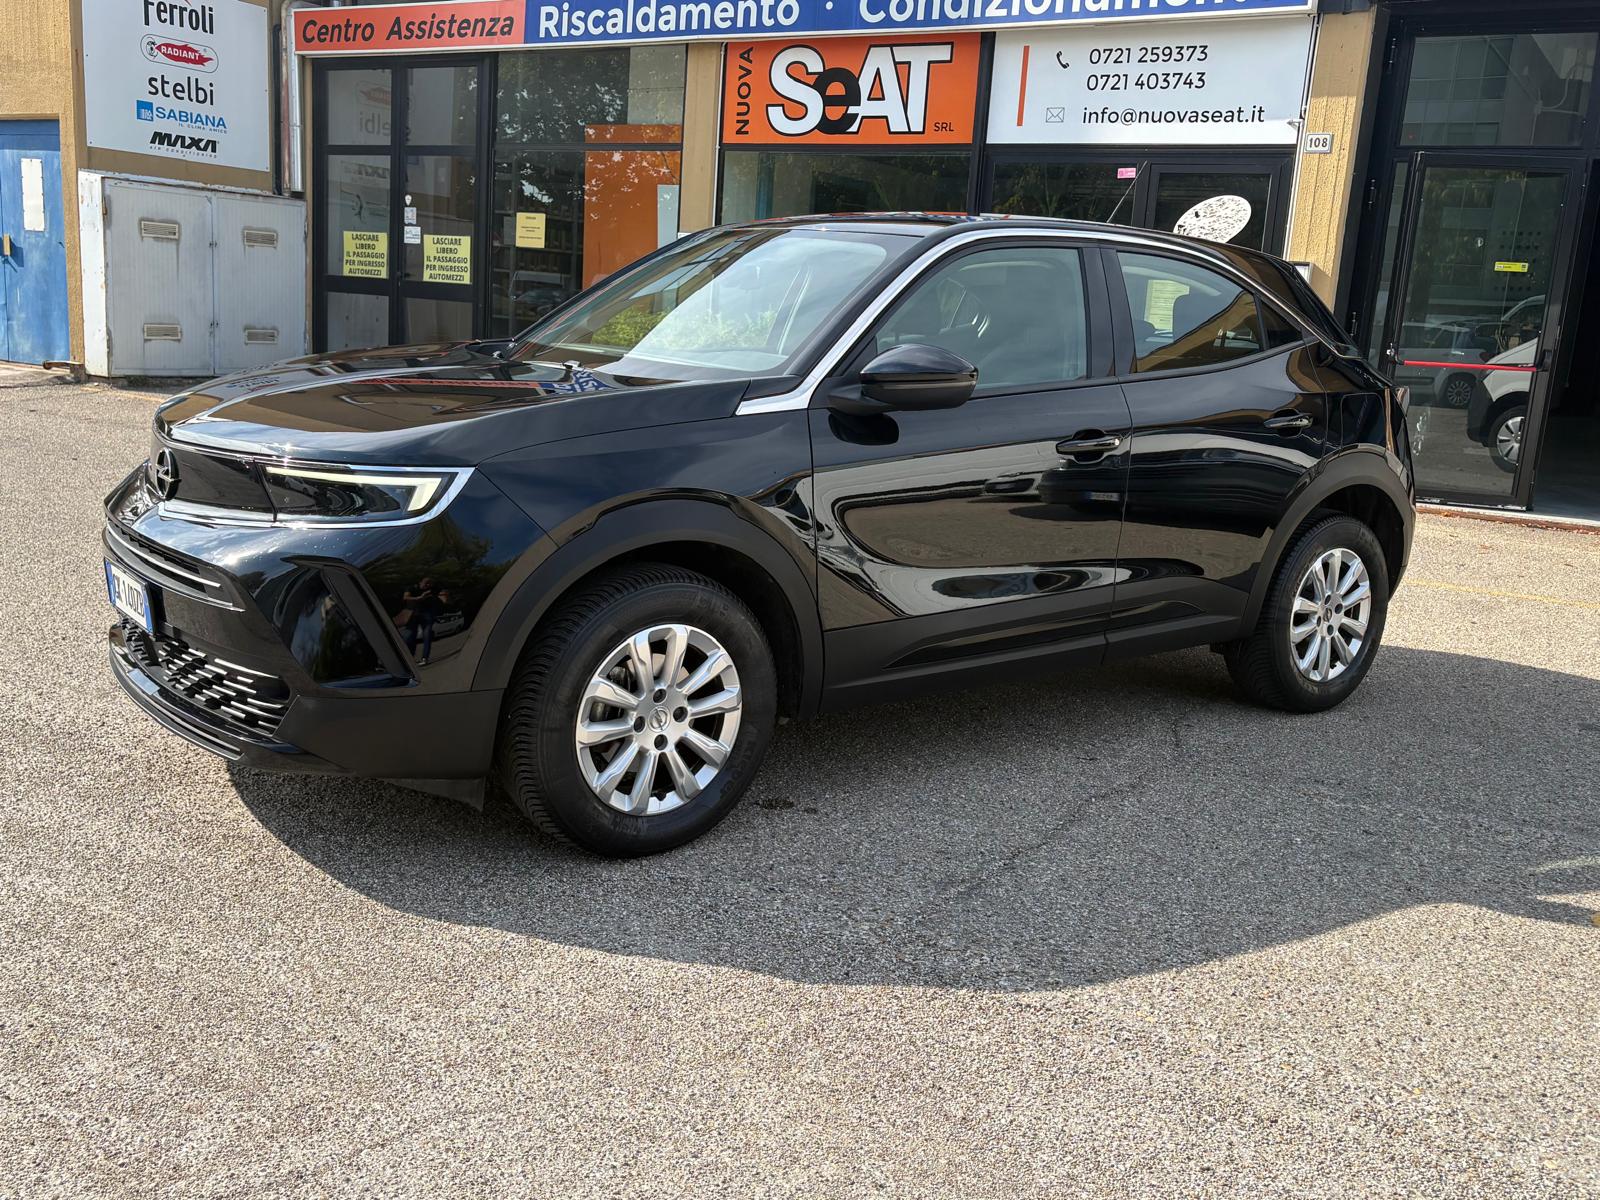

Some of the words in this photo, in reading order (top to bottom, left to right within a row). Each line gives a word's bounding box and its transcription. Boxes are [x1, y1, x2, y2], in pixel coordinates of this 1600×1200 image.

[144, 0, 214, 34] Ferroli
[539, 0, 800, 38] Riscaldamento
[302, 19, 375, 44] Centro
[386, 13, 514, 41] Assistenza
[160, 45, 200, 60] RADIANT
[1089, 47, 1131, 64] 0721
[1137, 45, 1209, 63] 259373
[1086, 73, 1128, 91] 0721
[1135, 72, 1206, 90] 403743
[148, 75, 214, 105] stelbi
[735, 47, 754, 135] NUOVA
[155, 106, 227, 129] SABIANA
[1082, 105, 1265, 126] info@nuovaseat.it
[934, 121, 954, 132] SRL
[149, 131, 217, 153] MAXA
[1308, 136, 1328, 149] 108
[351, 233, 379, 242] LASCIARE
[432, 237, 462, 246] LASCIARE
[355, 242, 376, 250] LIBERO
[436, 247, 458, 255] LIBERO
[352, 251, 385, 259] PASSAGGIO
[433, 256, 468, 264] PASSAGGIO
[357, 260, 385, 268] INGRESSO
[438, 264, 468, 273] INGRESSO
[348, 268, 382, 276] AUTOMEZZI
[428, 272, 465, 281] AUTOMEZZI
